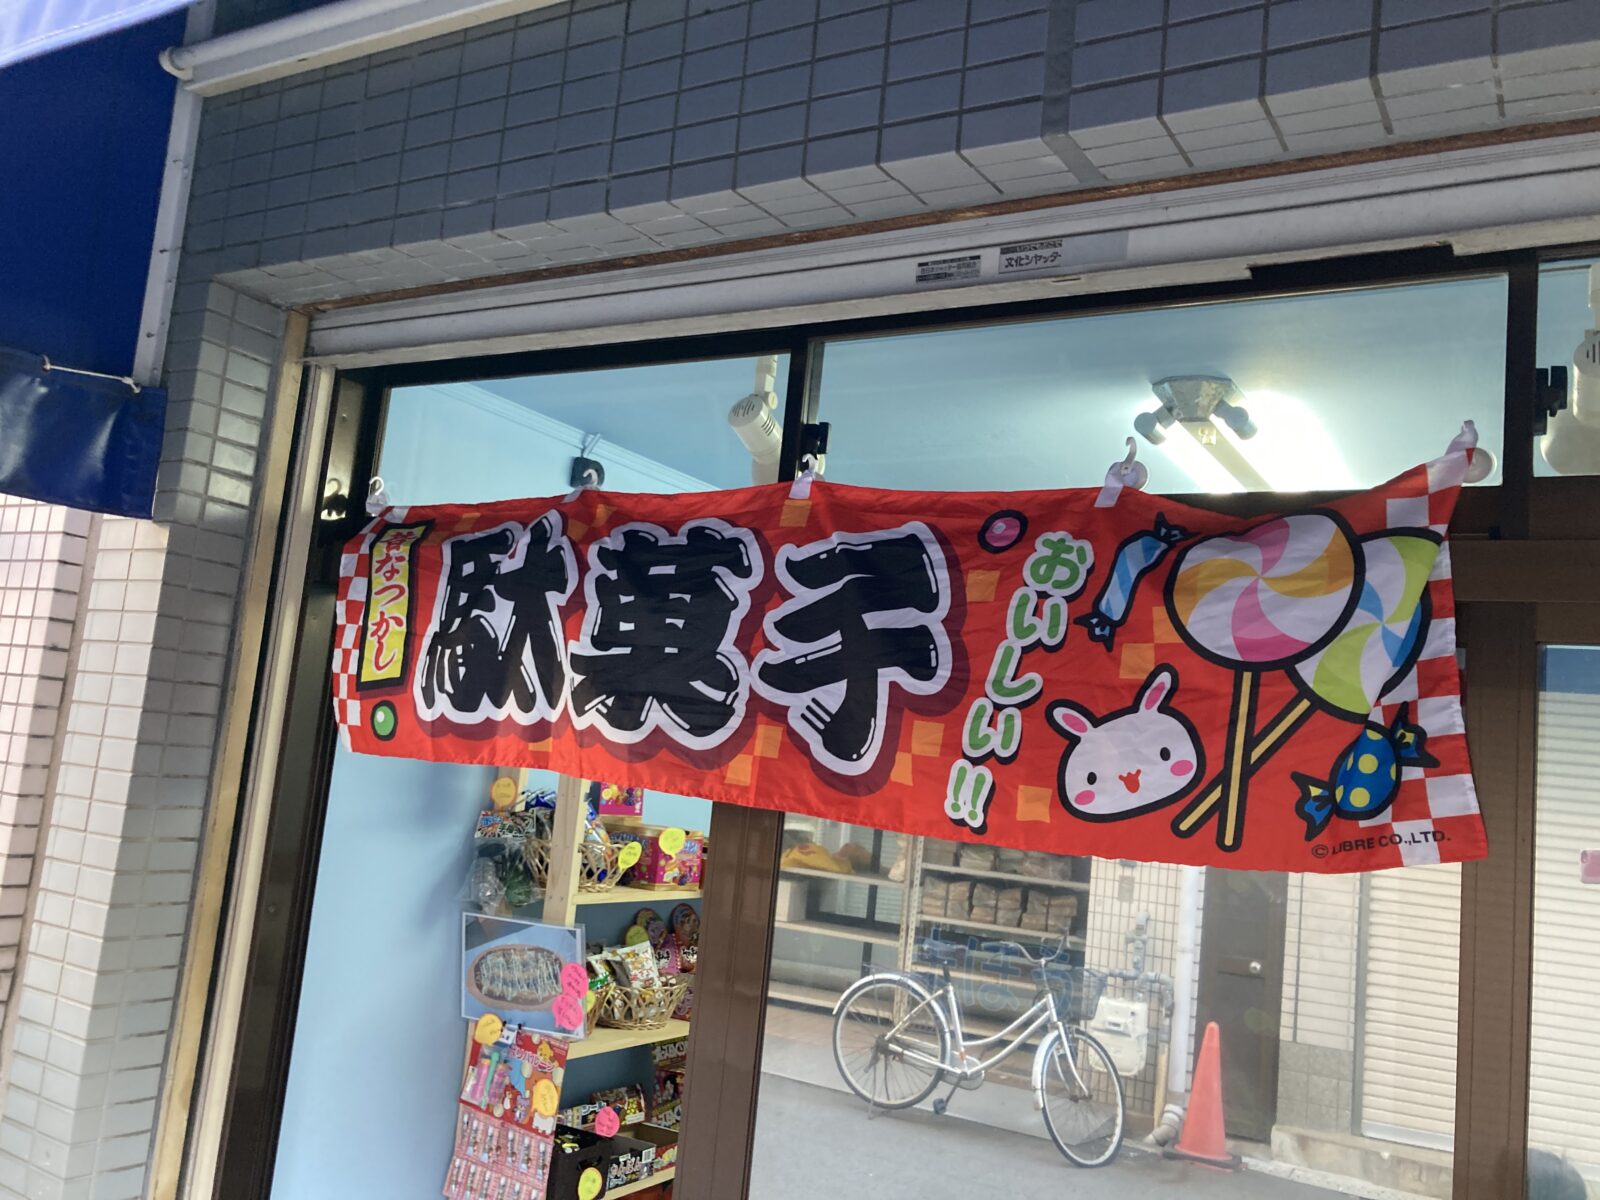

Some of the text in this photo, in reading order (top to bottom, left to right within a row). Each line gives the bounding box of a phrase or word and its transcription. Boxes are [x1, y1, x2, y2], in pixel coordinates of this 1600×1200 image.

[369, 530, 417, 673] 昔なつかし
[418, 509, 946, 768] 駄菓子
[1377, 829, 1452, 848] CO.,LTD.
